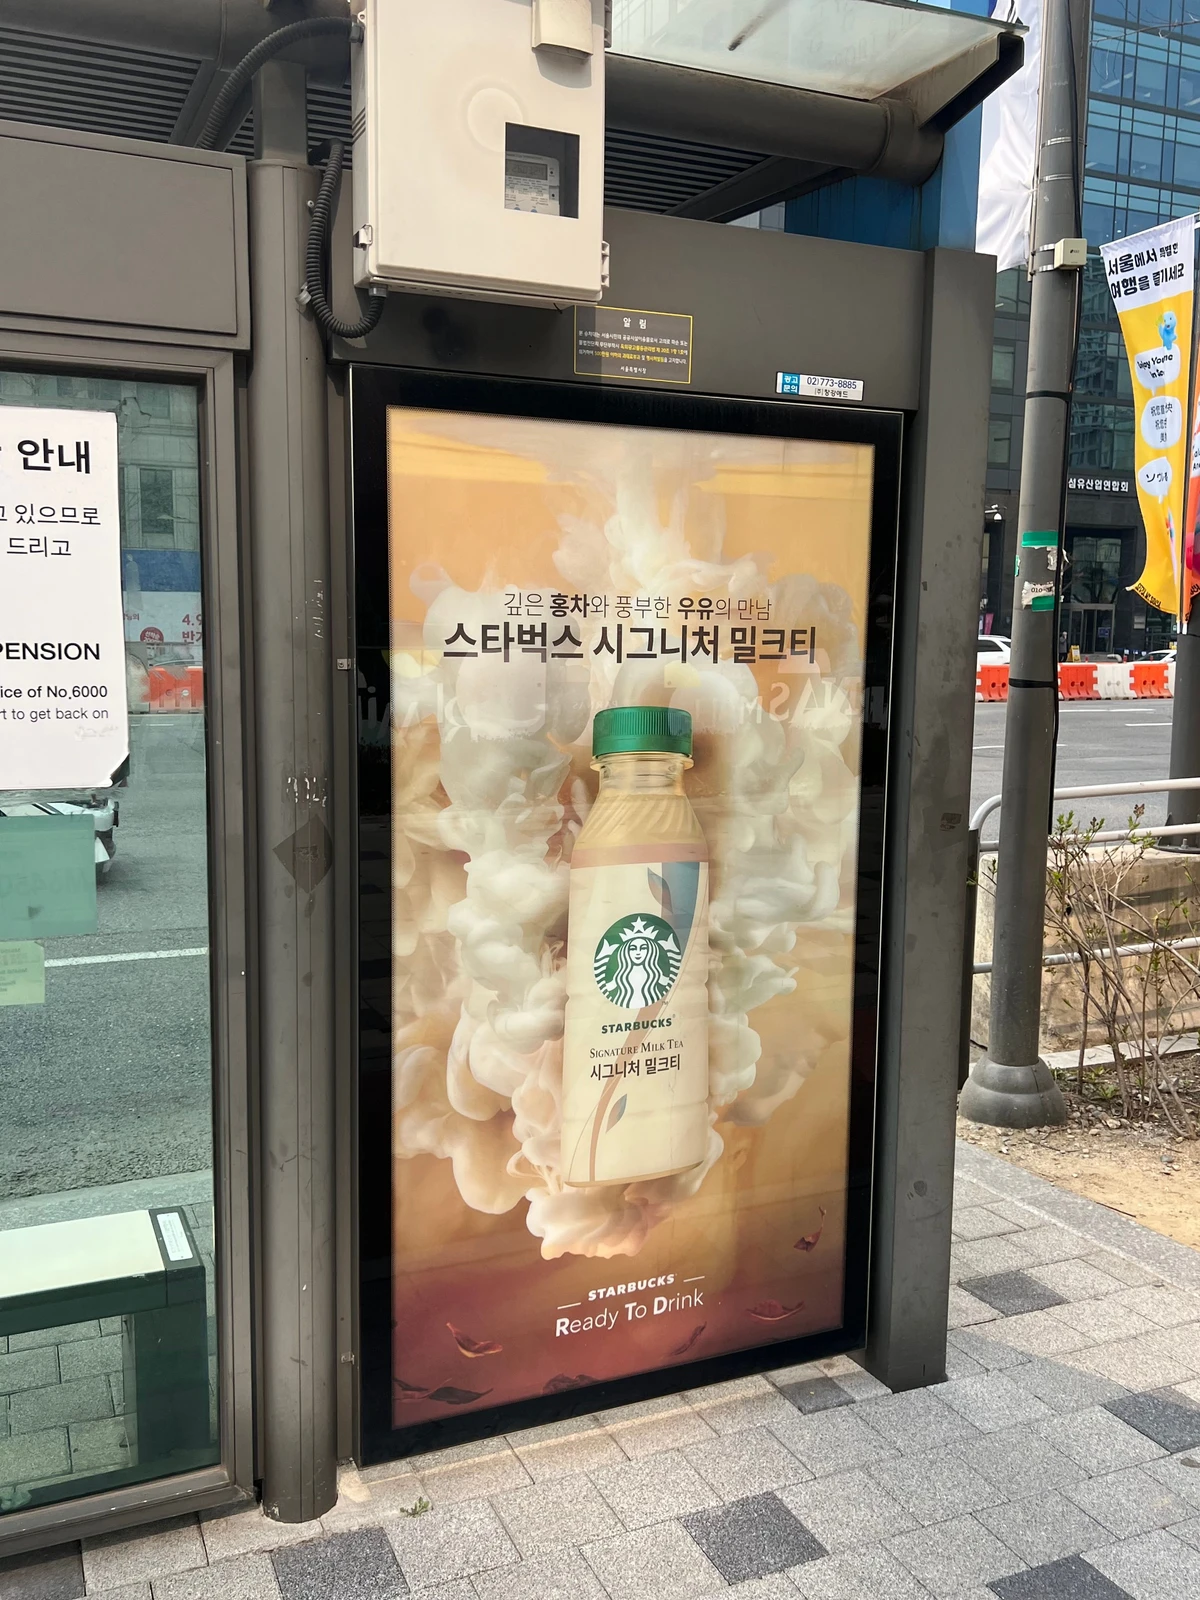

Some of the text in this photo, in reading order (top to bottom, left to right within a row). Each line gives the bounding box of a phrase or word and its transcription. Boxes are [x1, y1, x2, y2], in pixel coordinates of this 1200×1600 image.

[1108, 248, 1157, 276] 서울에서
[1111, 275, 1150, 299] 여행을
[783, 385, 798, 393] 문의
[784, 376, 798, 384] 광고
[807, 377, 857, 389] 02)773-8885
[17, 438, 90, 474] 안내
[15, 503, 101, 525] 있으므로
[7, 536, 71, 557] 드리고
[504, 592, 772, 621] 깊은 홍차와 풍부한 우유의 만남
[0, 642, 100, 660] ENSION
[443, 621, 816, 664] 스타벅스 시그니처 밀크티
[27, 686, 42, 698] of
[47, 685, 107, 700] No.6000
[11, 709, 25, 720] to
[30, 708, 51, 722] get
[56, 708, 88, 719] back
[92, 709, 109, 719] on
[601, 1018, 672, 1034] STARBUCKS
[590, 1054, 681, 1081] 시그니처 밀크티
[588, 1274, 675, 1301] STARBUCKS
[556, 1288, 704, 1337] Ready To Drink
